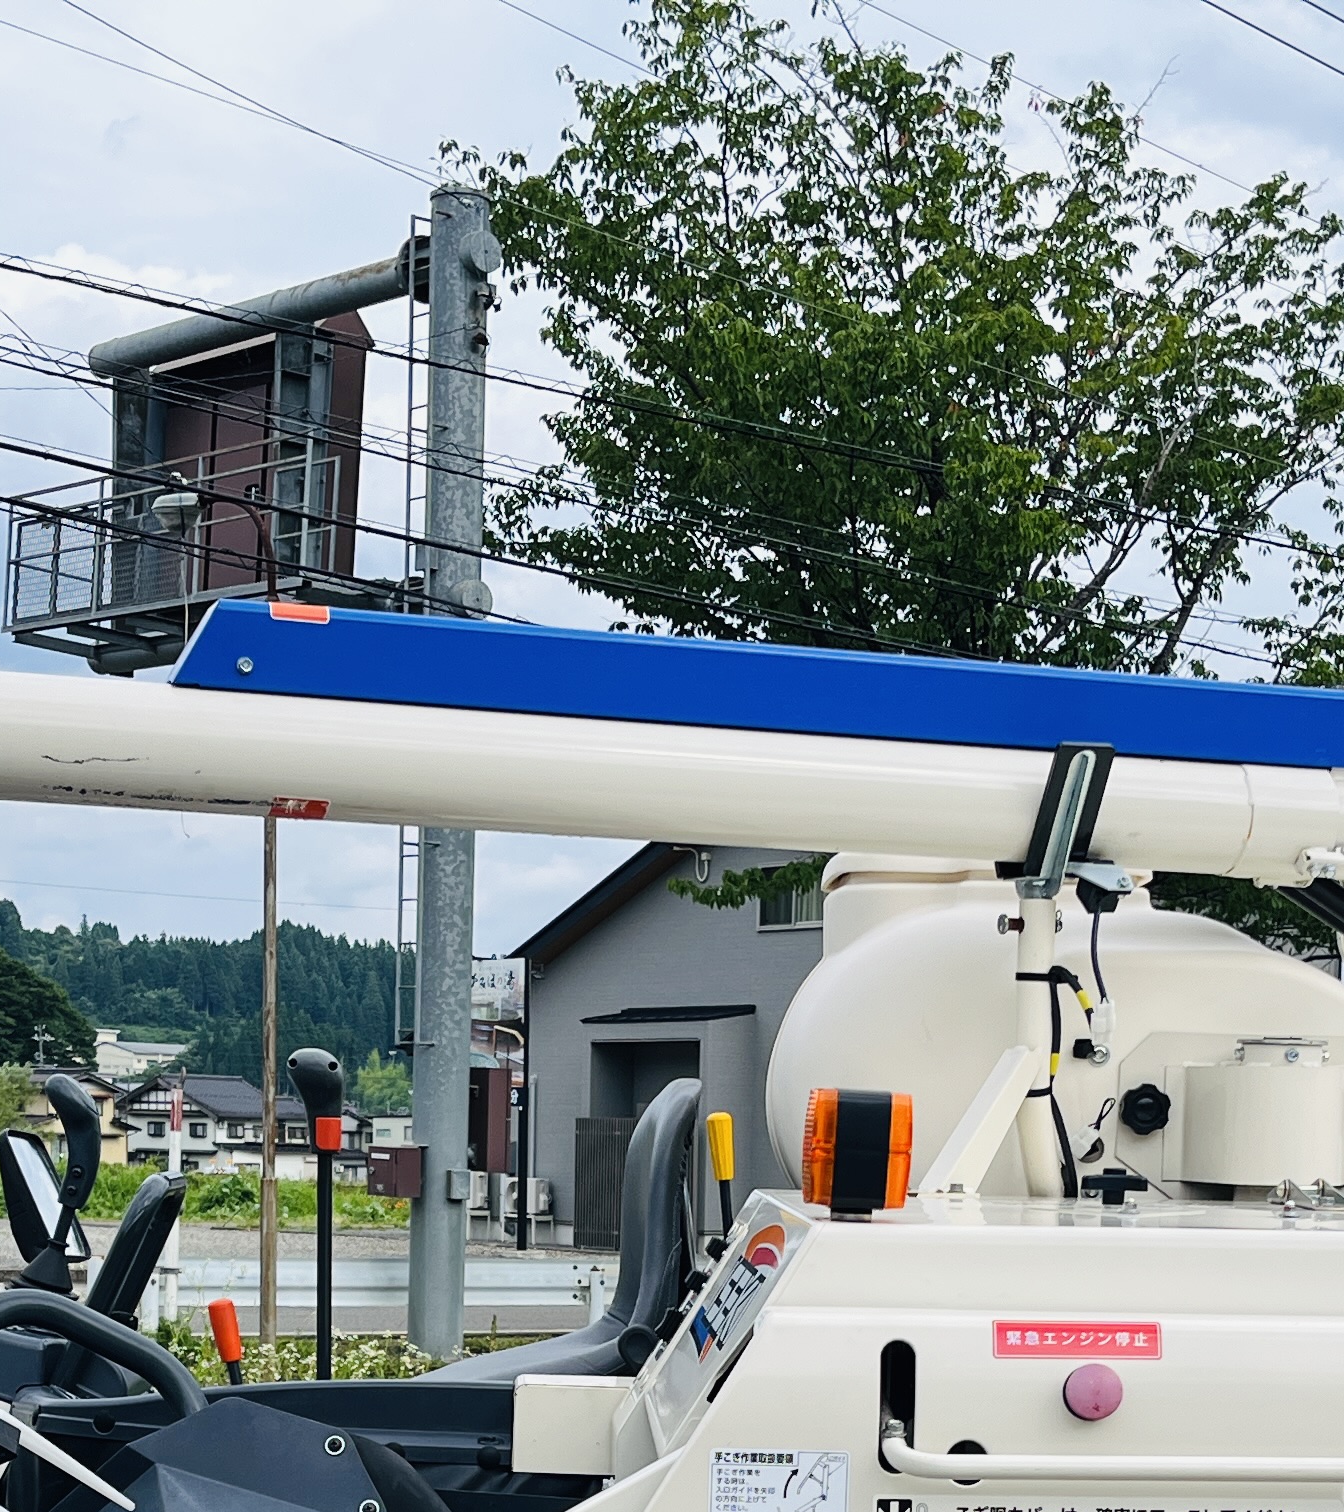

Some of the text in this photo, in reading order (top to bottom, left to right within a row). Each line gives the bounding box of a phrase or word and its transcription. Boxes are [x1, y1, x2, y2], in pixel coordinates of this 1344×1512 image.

[1006, 1330, 1149, 1347] 緊急エンジン停止
